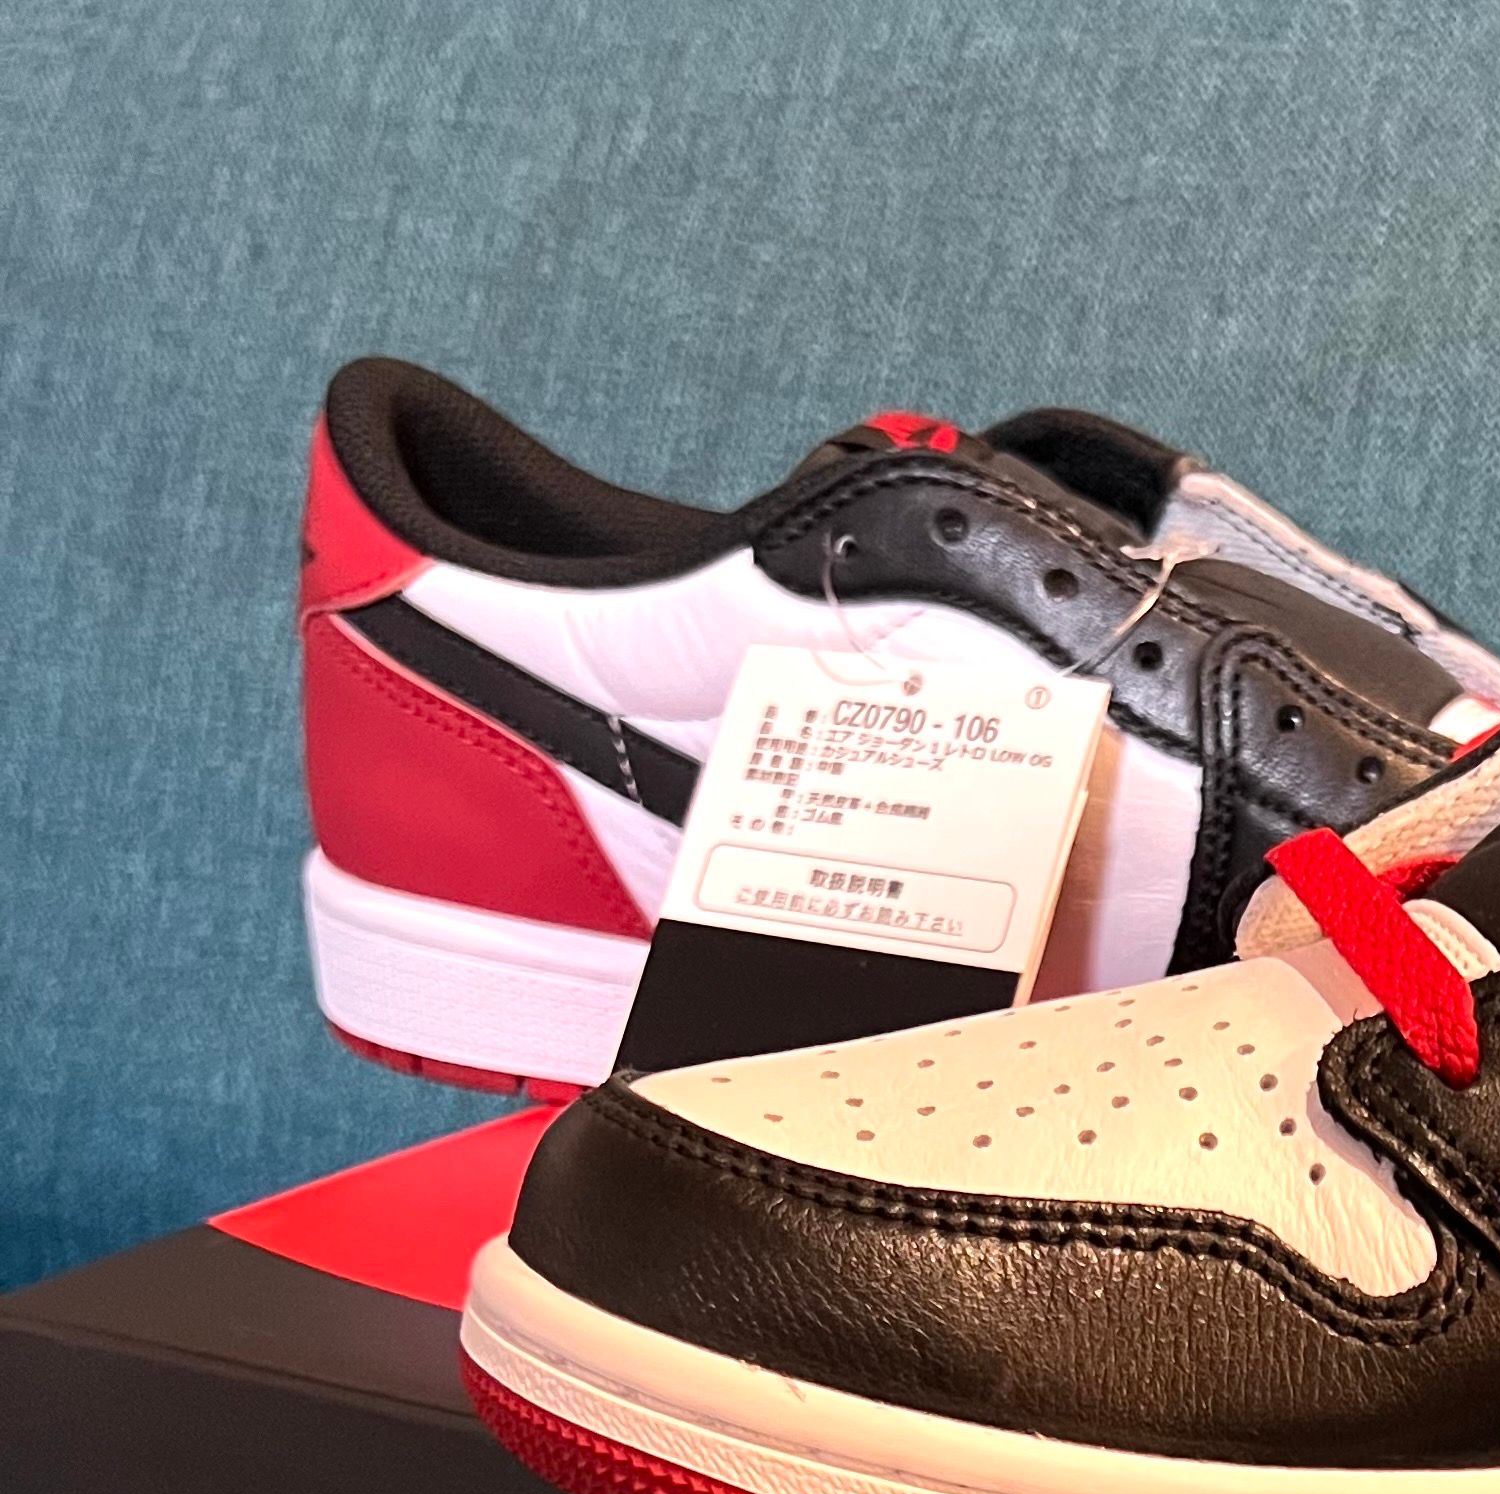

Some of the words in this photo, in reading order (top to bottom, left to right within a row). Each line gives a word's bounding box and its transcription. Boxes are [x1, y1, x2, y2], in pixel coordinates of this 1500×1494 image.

[832, 699, 927, 735] CZ0790
[954, 713, 1001, 744] 106
[810, 868, 904, 900] 取扱説明書
